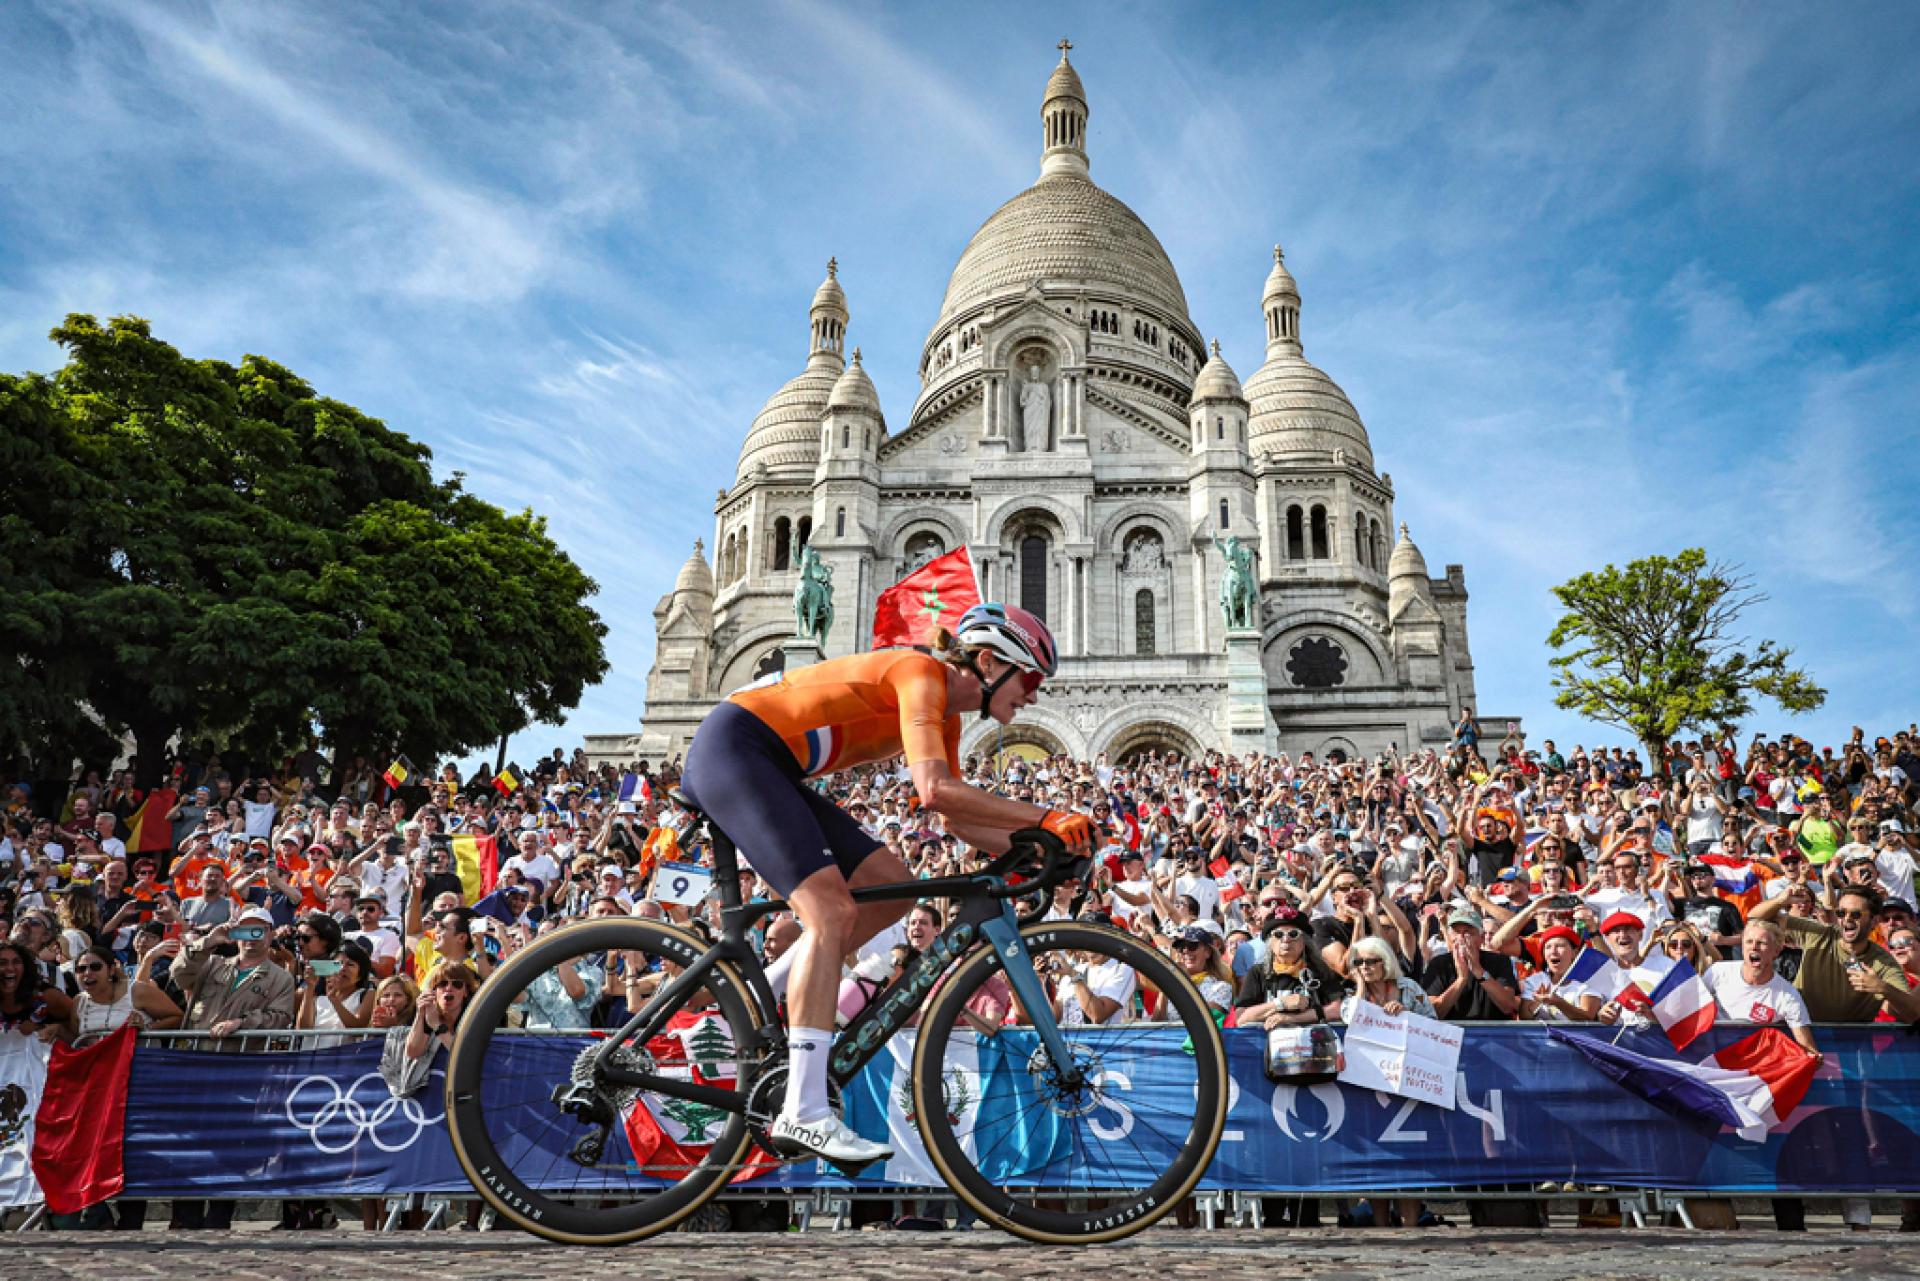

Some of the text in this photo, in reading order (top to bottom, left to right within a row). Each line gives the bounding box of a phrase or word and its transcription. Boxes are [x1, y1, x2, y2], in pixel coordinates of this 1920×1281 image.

[672, 876, 690, 897] 9
[661, 937, 727, 987] RESEVE
[481, 1165, 542, 1220] RESERVE
[1084, 1196, 1155, 1232] RESERVE
